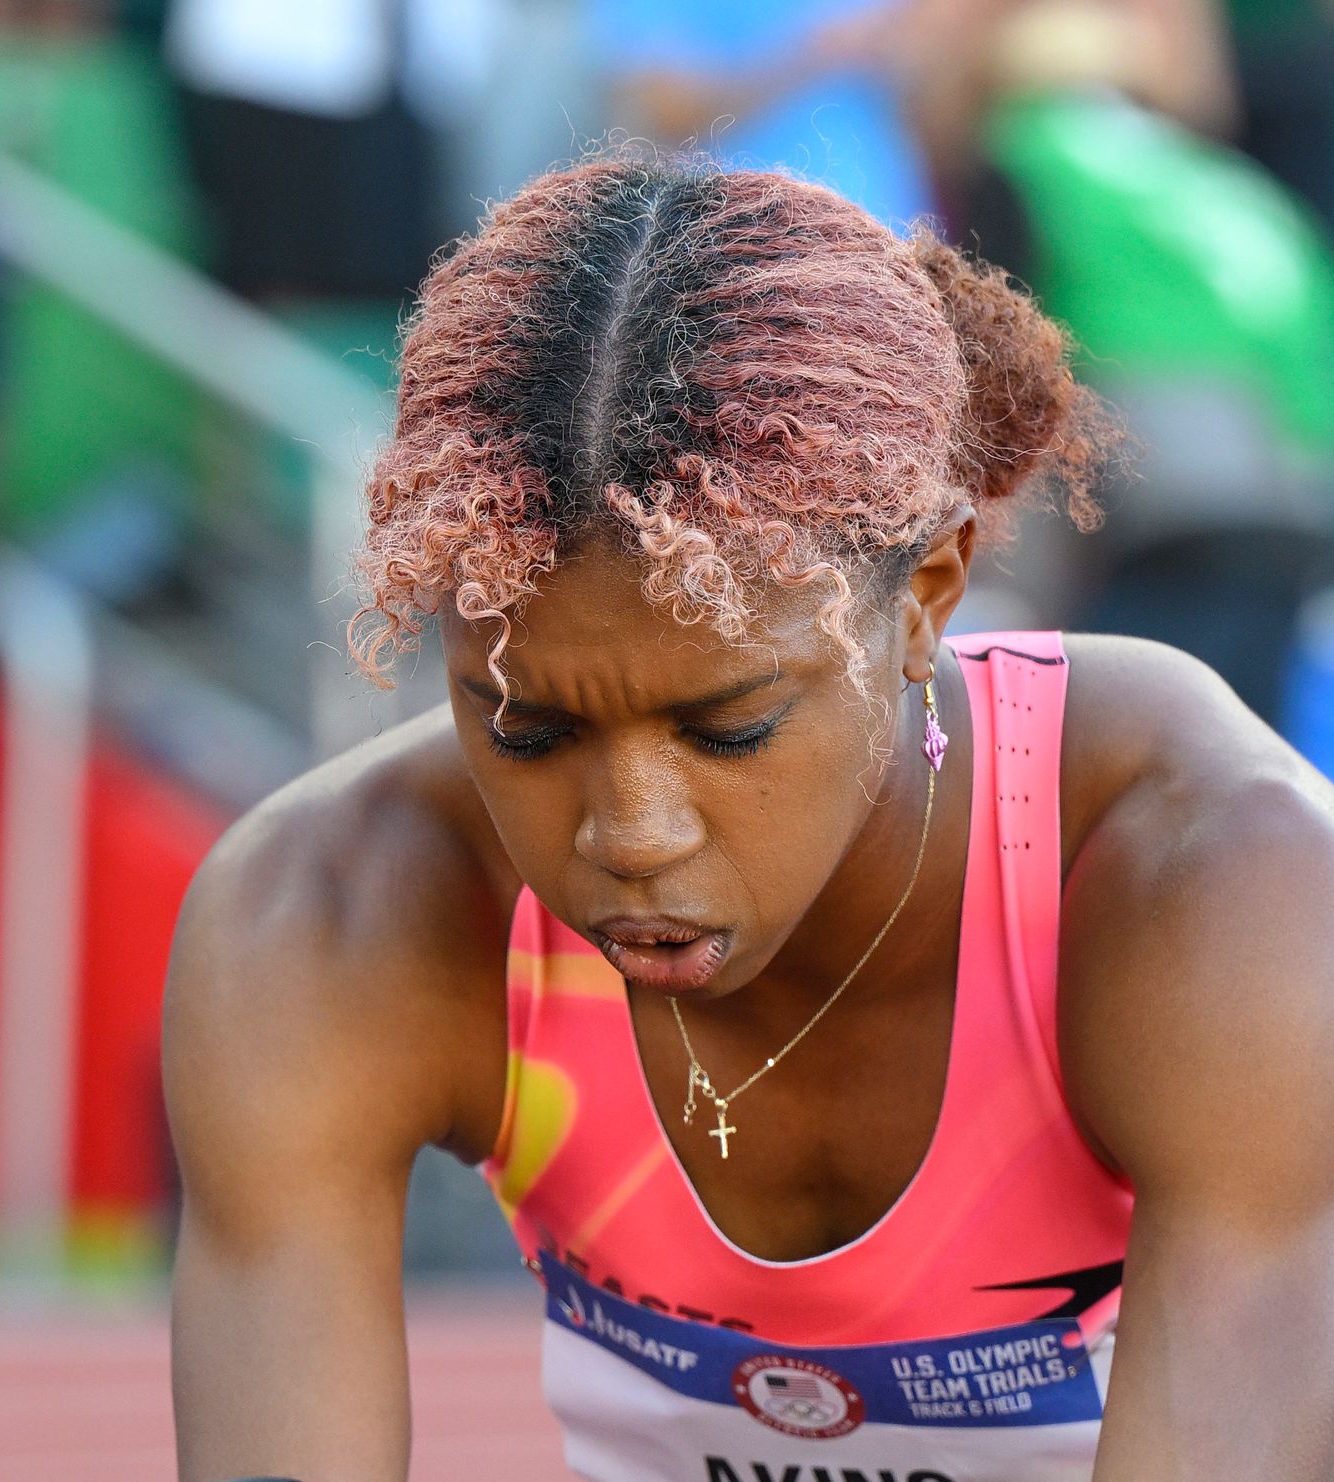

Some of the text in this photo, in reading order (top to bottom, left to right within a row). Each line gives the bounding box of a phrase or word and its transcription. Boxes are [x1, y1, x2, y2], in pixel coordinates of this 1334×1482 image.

[607, 1319, 700, 1372] USATF
[891, 1334, 1061, 1380] U.S. OLYMPIC
[898, 1358, 1067, 1401] TEAM TRIALS
[910, 1401, 966, 1419] TRACK
[984, 1391, 1033, 1415] FIELD
